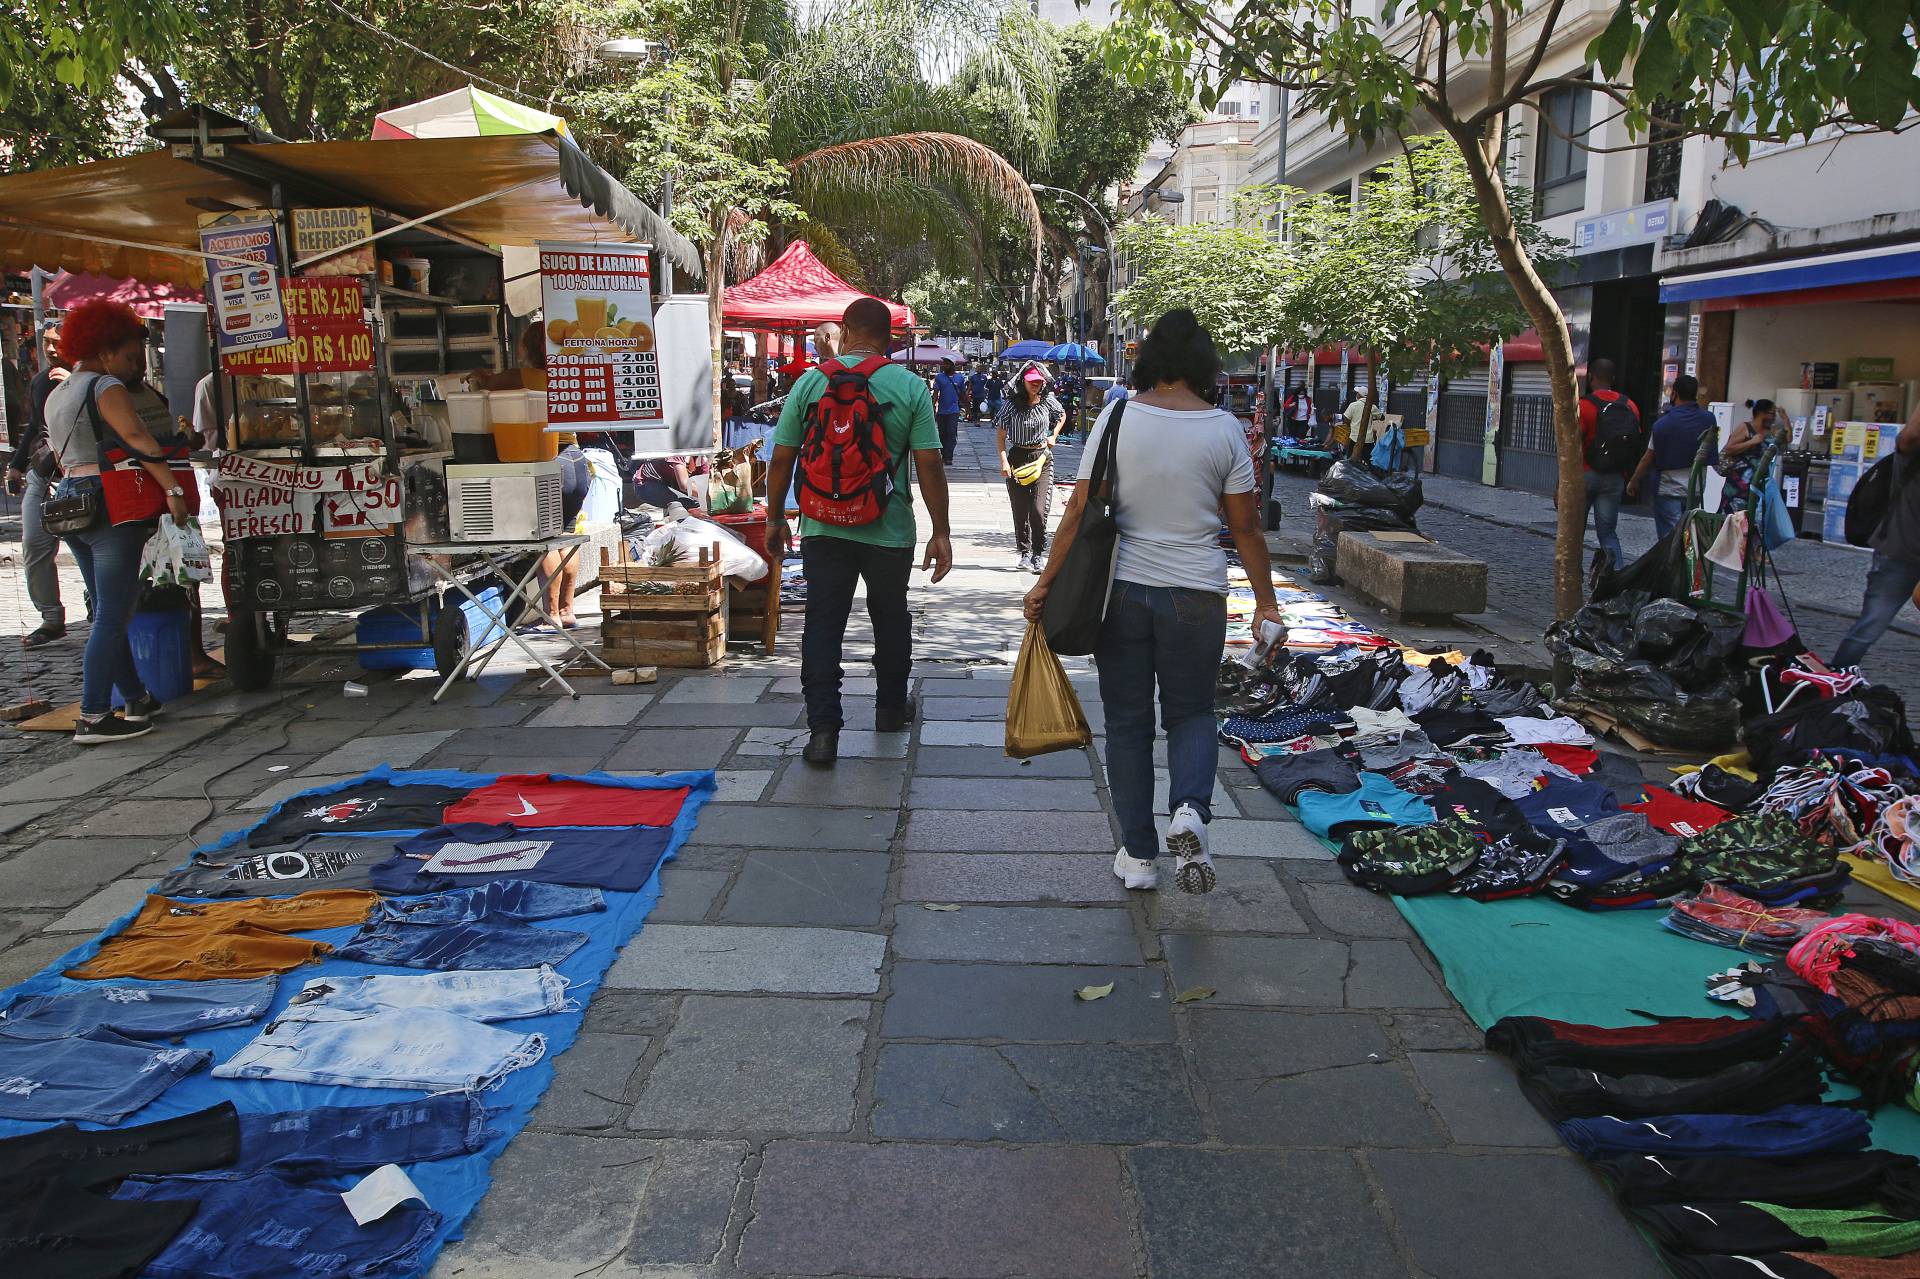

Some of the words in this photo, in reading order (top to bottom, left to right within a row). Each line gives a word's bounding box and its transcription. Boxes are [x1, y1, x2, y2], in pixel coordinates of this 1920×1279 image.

[297, 209, 358, 229] SALGADO
[209, 233, 270, 251] ACEITAMOS
[542, 254, 577, 271] SUCO
[579, 255, 595, 271] DE
[596, 256, 647, 272] LARANJA
[551, 274, 588, 290] 100%
[589, 275, 642, 291] NATURAL
[228, 298, 242, 306] VISA
[254, 293, 271, 301] VISA
[311, 288, 329, 317] R$
[332, 287, 360, 319] 2,50
[243, 332, 272, 342] OUTROS
[312, 335, 333, 364] R$
[338, 334, 370, 367] 1,00
[547, 355, 579, 365] 200
[583, 354, 604, 364] ml
[622, 353, 655, 362] 2.00
[547, 367, 580, 377] 300
[584, 367, 605, 376] ml
[622, 365, 655, 374] 3.00
[548, 379, 580, 389] 400
[585, 379, 605, 389] ml
[622, 377, 656, 386] 4.00
[548, 391, 582, 401] 500
[585, 391, 606, 400] ml
[623, 389, 657, 398] 5.00
[548, 404, 579, 414] 700
[585, 403, 607, 413] ml
[623, 400, 657, 409] 7.00
